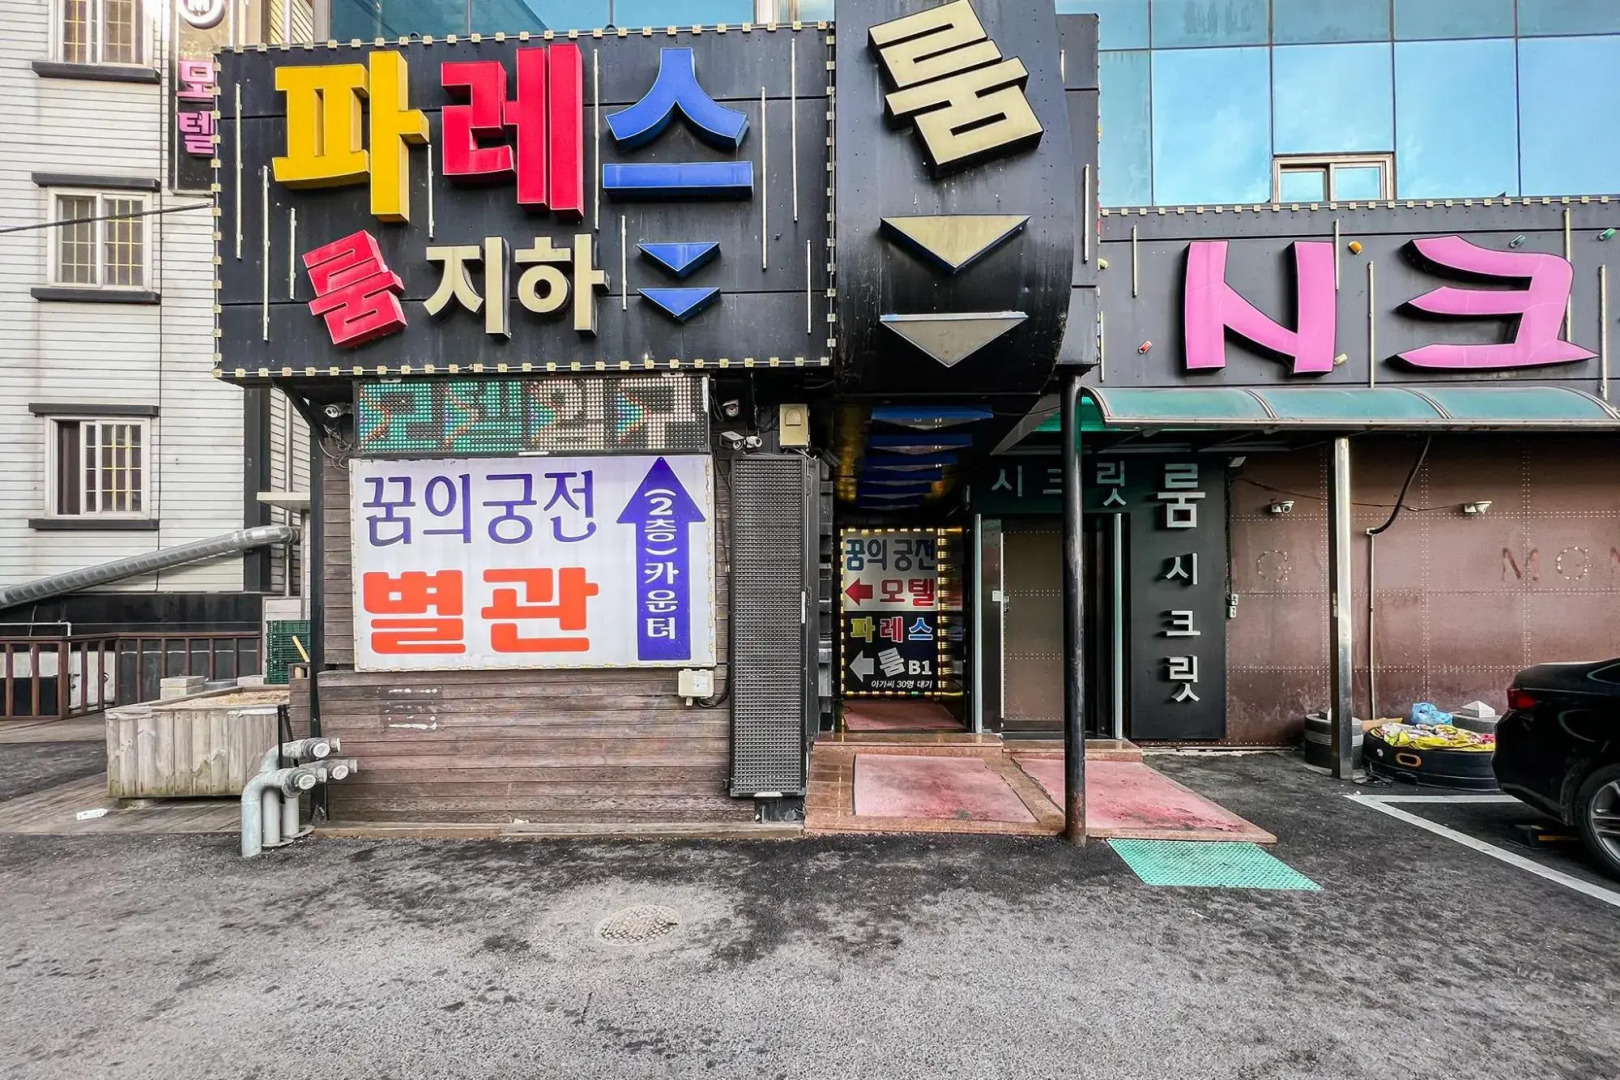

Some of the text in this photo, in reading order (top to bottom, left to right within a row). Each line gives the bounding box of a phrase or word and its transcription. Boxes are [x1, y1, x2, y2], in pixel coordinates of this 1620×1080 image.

[176, 60, 214, 155] 모텔
[867, 0, 1043, 178] 룸
[272, 44, 754, 223] 파레스
[302, 229, 611, 348] 룸 지하
[1157, 463, 1206, 528] 룸
[362, 567, 599, 654] 별관
[850, 616, 934, 643] 파레스
[880, 578, 935, 607] 모텔
[908, 660, 932, 675] B1
